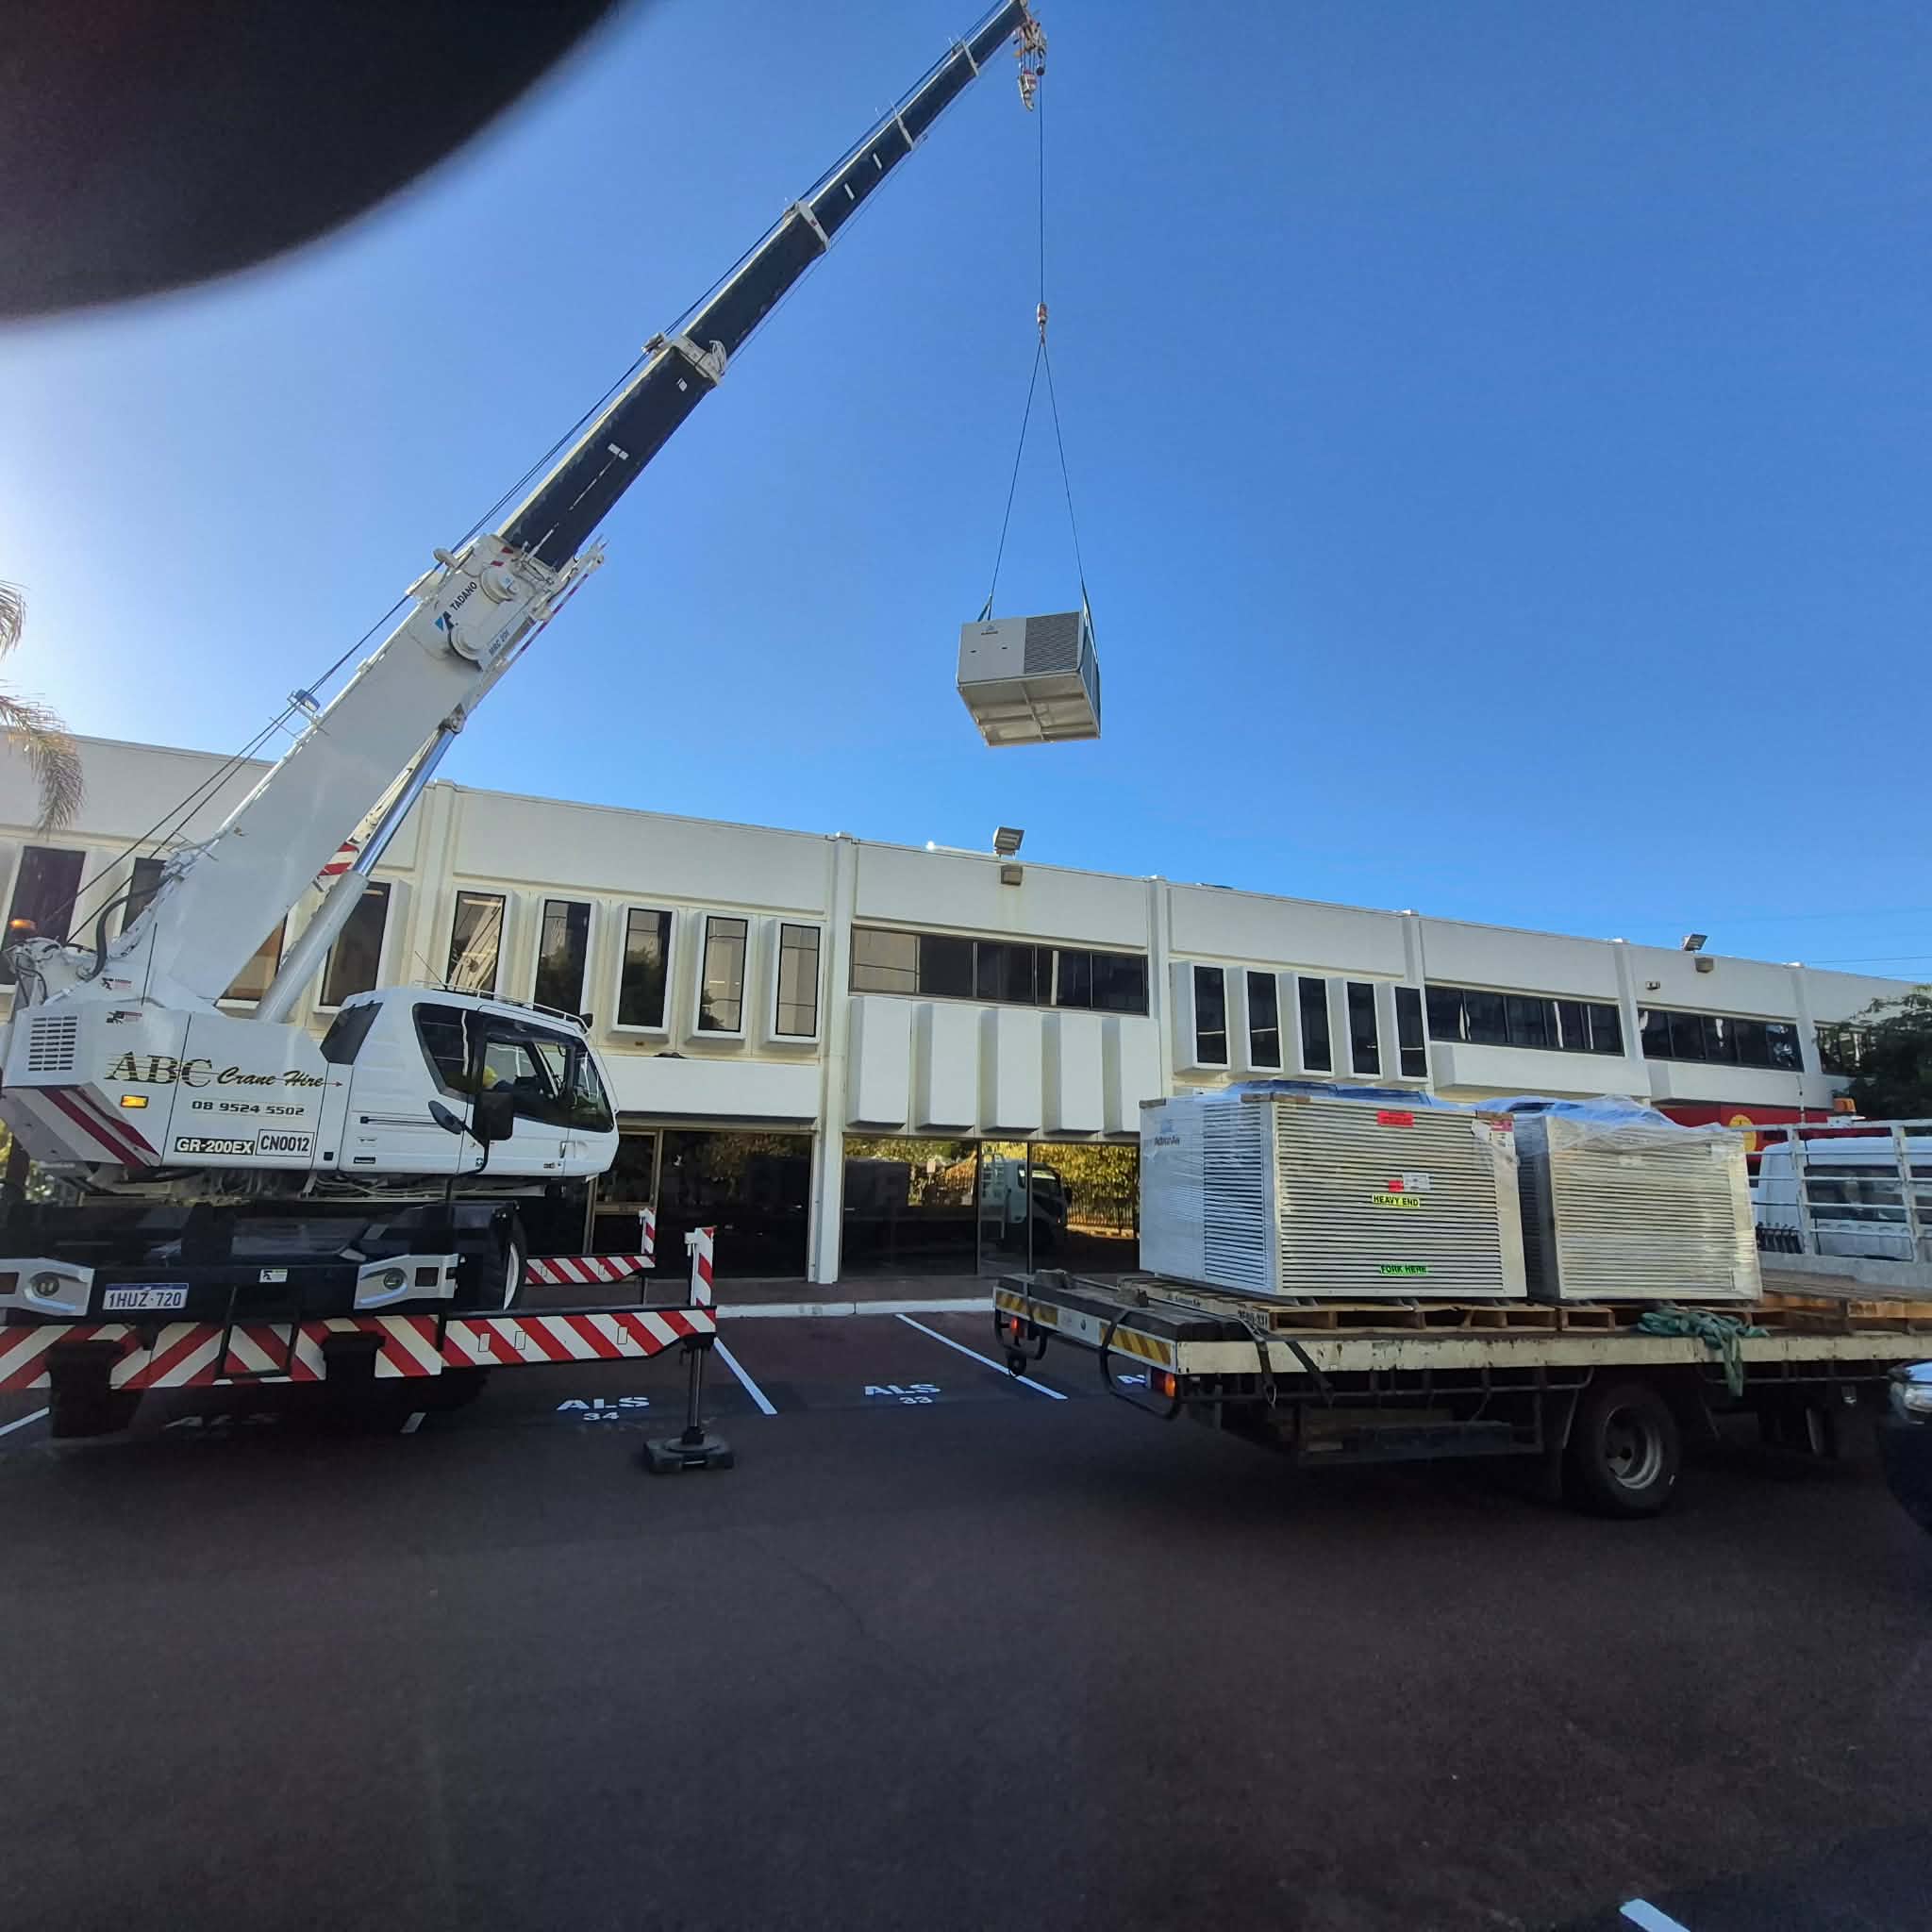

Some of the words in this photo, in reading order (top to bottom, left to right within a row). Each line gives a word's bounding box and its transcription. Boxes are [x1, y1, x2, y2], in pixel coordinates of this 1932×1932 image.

[449, 581, 477, 611] TADANO
[104, 1051, 213, 1088] ABC
[217, 1066, 276, 1086] Crane
[282, 1070, 325, 1088] Hire
[192, 1100, 213, 1110] 08
[219, 1102, 260, 1114] 9524
[265, 1106, 305, 1116] 5502
[176, 1138, 254, 1154] GR-200EX
[1374, 1194, 1399, 1205] HEAVY
[1402, 1197, 1419, 1207] END
[1381, 1265, 1403, 1274] FORK
[1405, 1265, 1426, 1274] HERE
[864, 1384, 941, 1395] ALS
[557, 1396, 650, 1410] ALS
[899, 1396, 933, 1405] 33
[583, 1411, 620, 1421] 34
